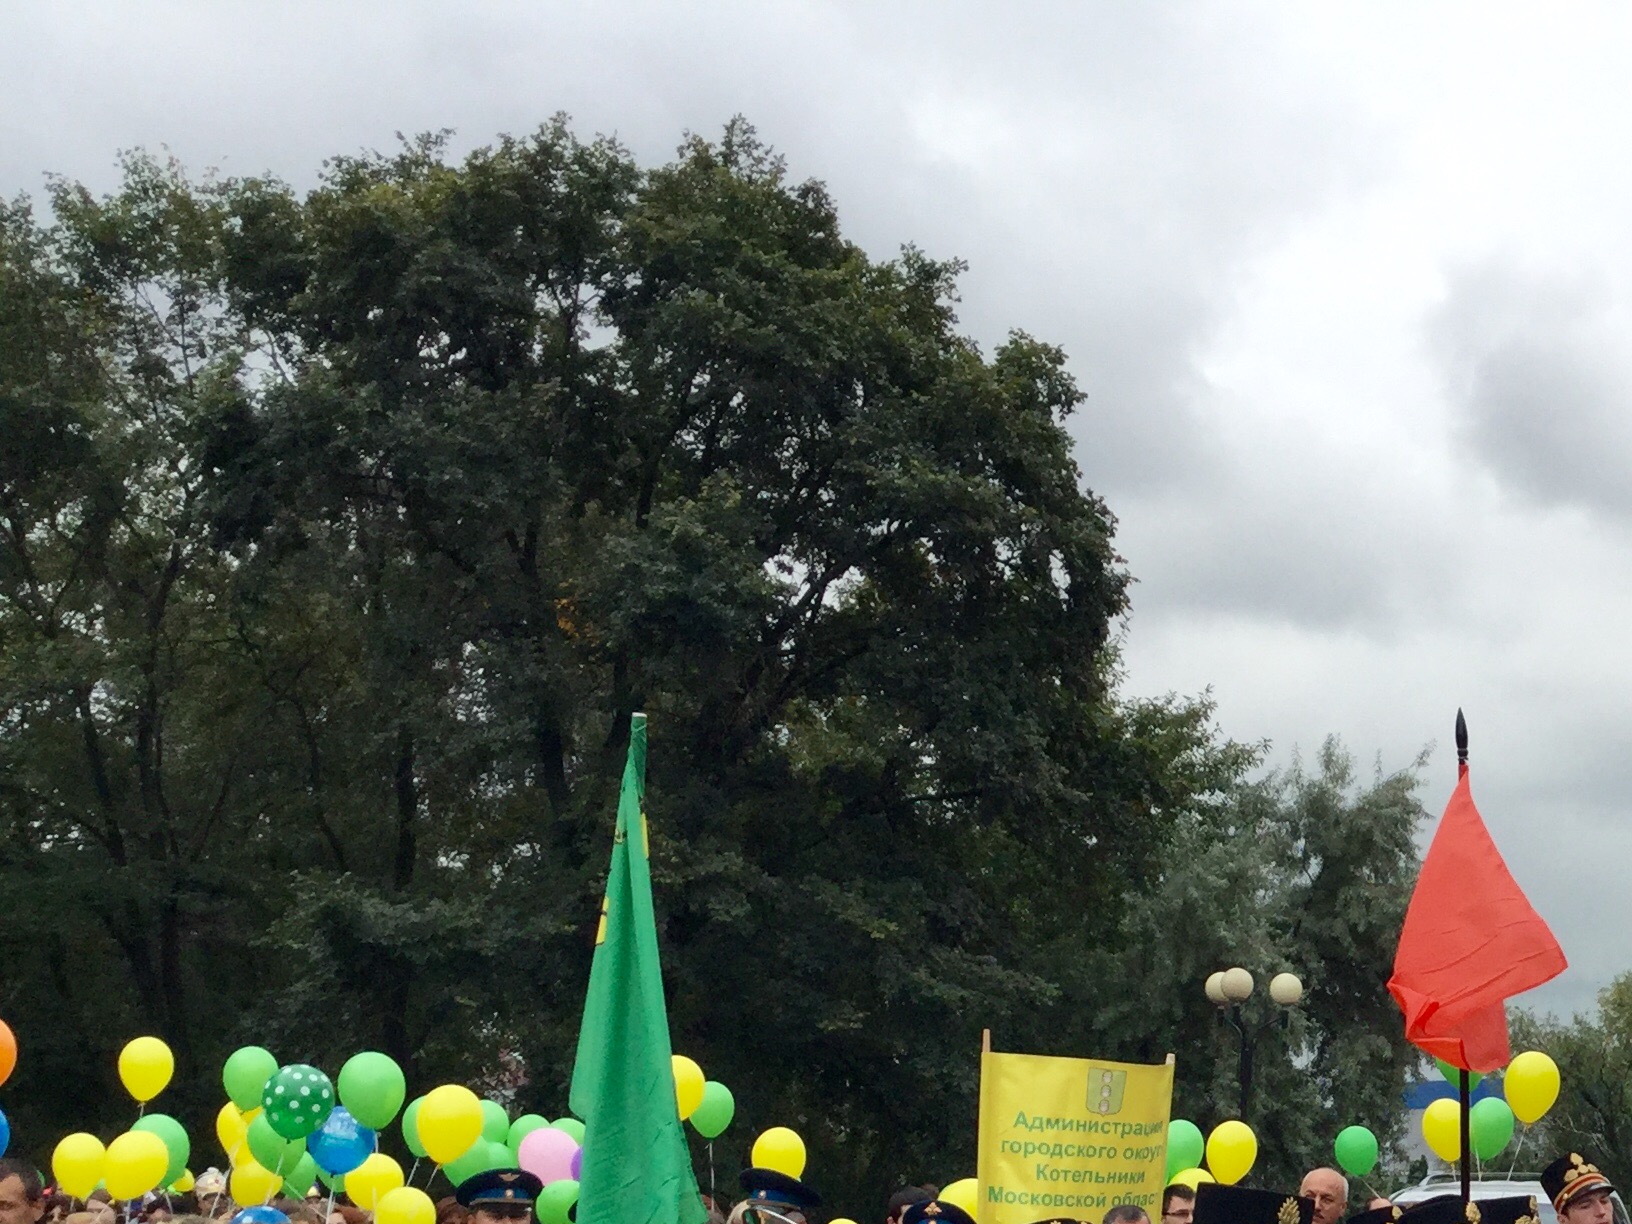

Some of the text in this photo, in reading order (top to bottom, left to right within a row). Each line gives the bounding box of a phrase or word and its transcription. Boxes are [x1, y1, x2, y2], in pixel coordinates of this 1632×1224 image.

[1001, 1139, 1117, 1159] городского
[1036, 1163, 1145, 1185] Котельники
[988, 1186, 1157, 1208] Московской облас
